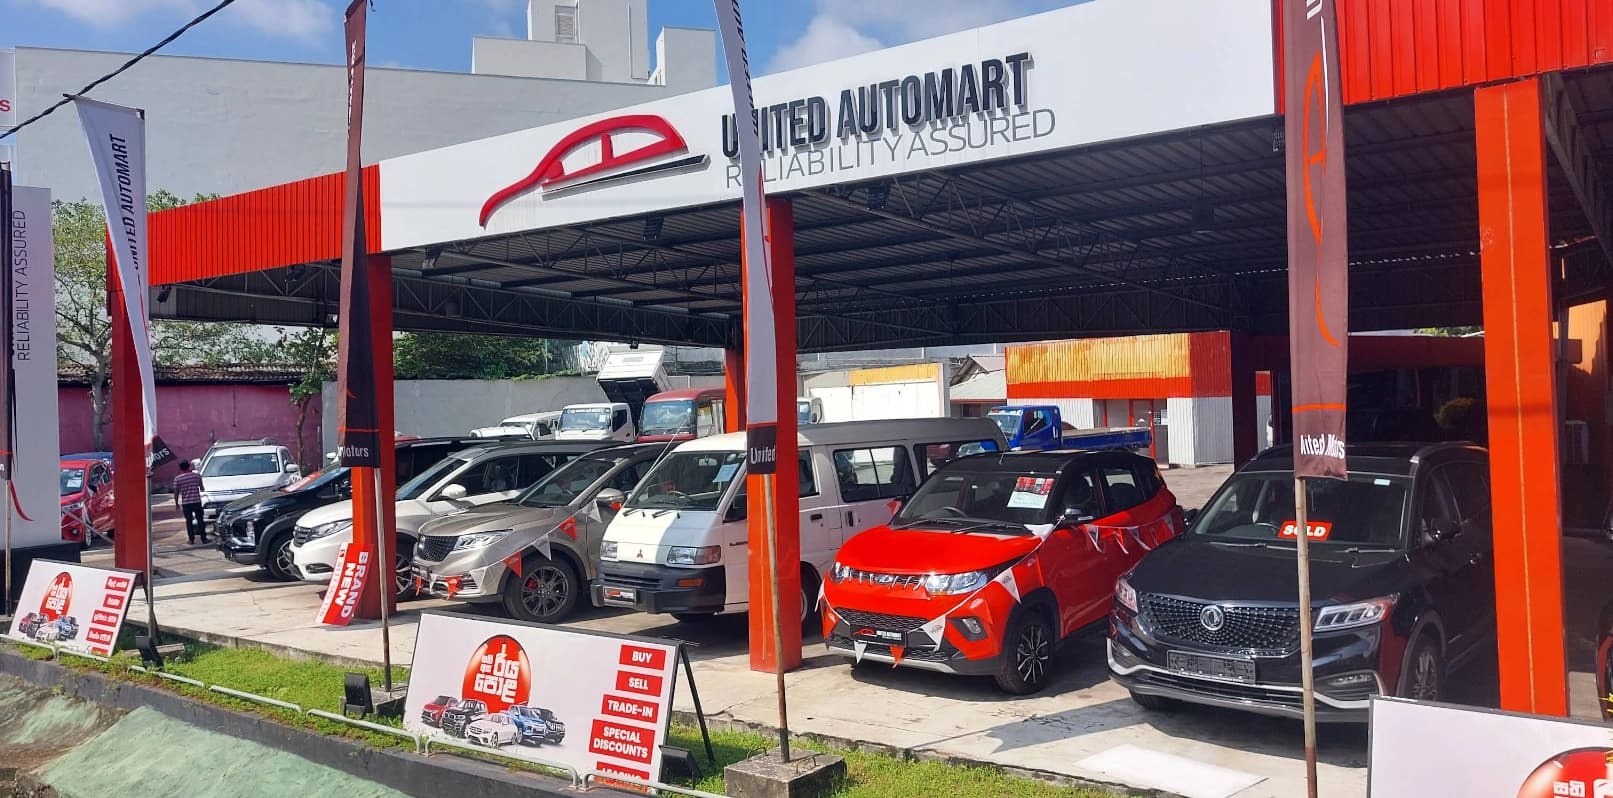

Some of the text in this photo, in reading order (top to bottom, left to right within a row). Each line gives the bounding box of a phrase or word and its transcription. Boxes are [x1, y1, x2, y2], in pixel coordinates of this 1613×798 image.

[722, 52, 1029, 157] UITED AUTOMART
[726, 108, 1056, 189] RLIABILITY ASSURED
[109, 133, 135, 215] AUTOMART
[12, 210, 31, 361] RELIABILITY ASSURED
[750, 444, 776, 464] United
[335, 562, 356, 606] NEW
[341, 551, 369, 617] BRAND
[632, 651, 653, 663] BUY
[628, 677, 649, 690] SELL
[607, 699, 654, 718] TRADE-IN
[593, 737, 649, 759] DISCOUNTS
[603, 726, 641, 743] SPECIAL
